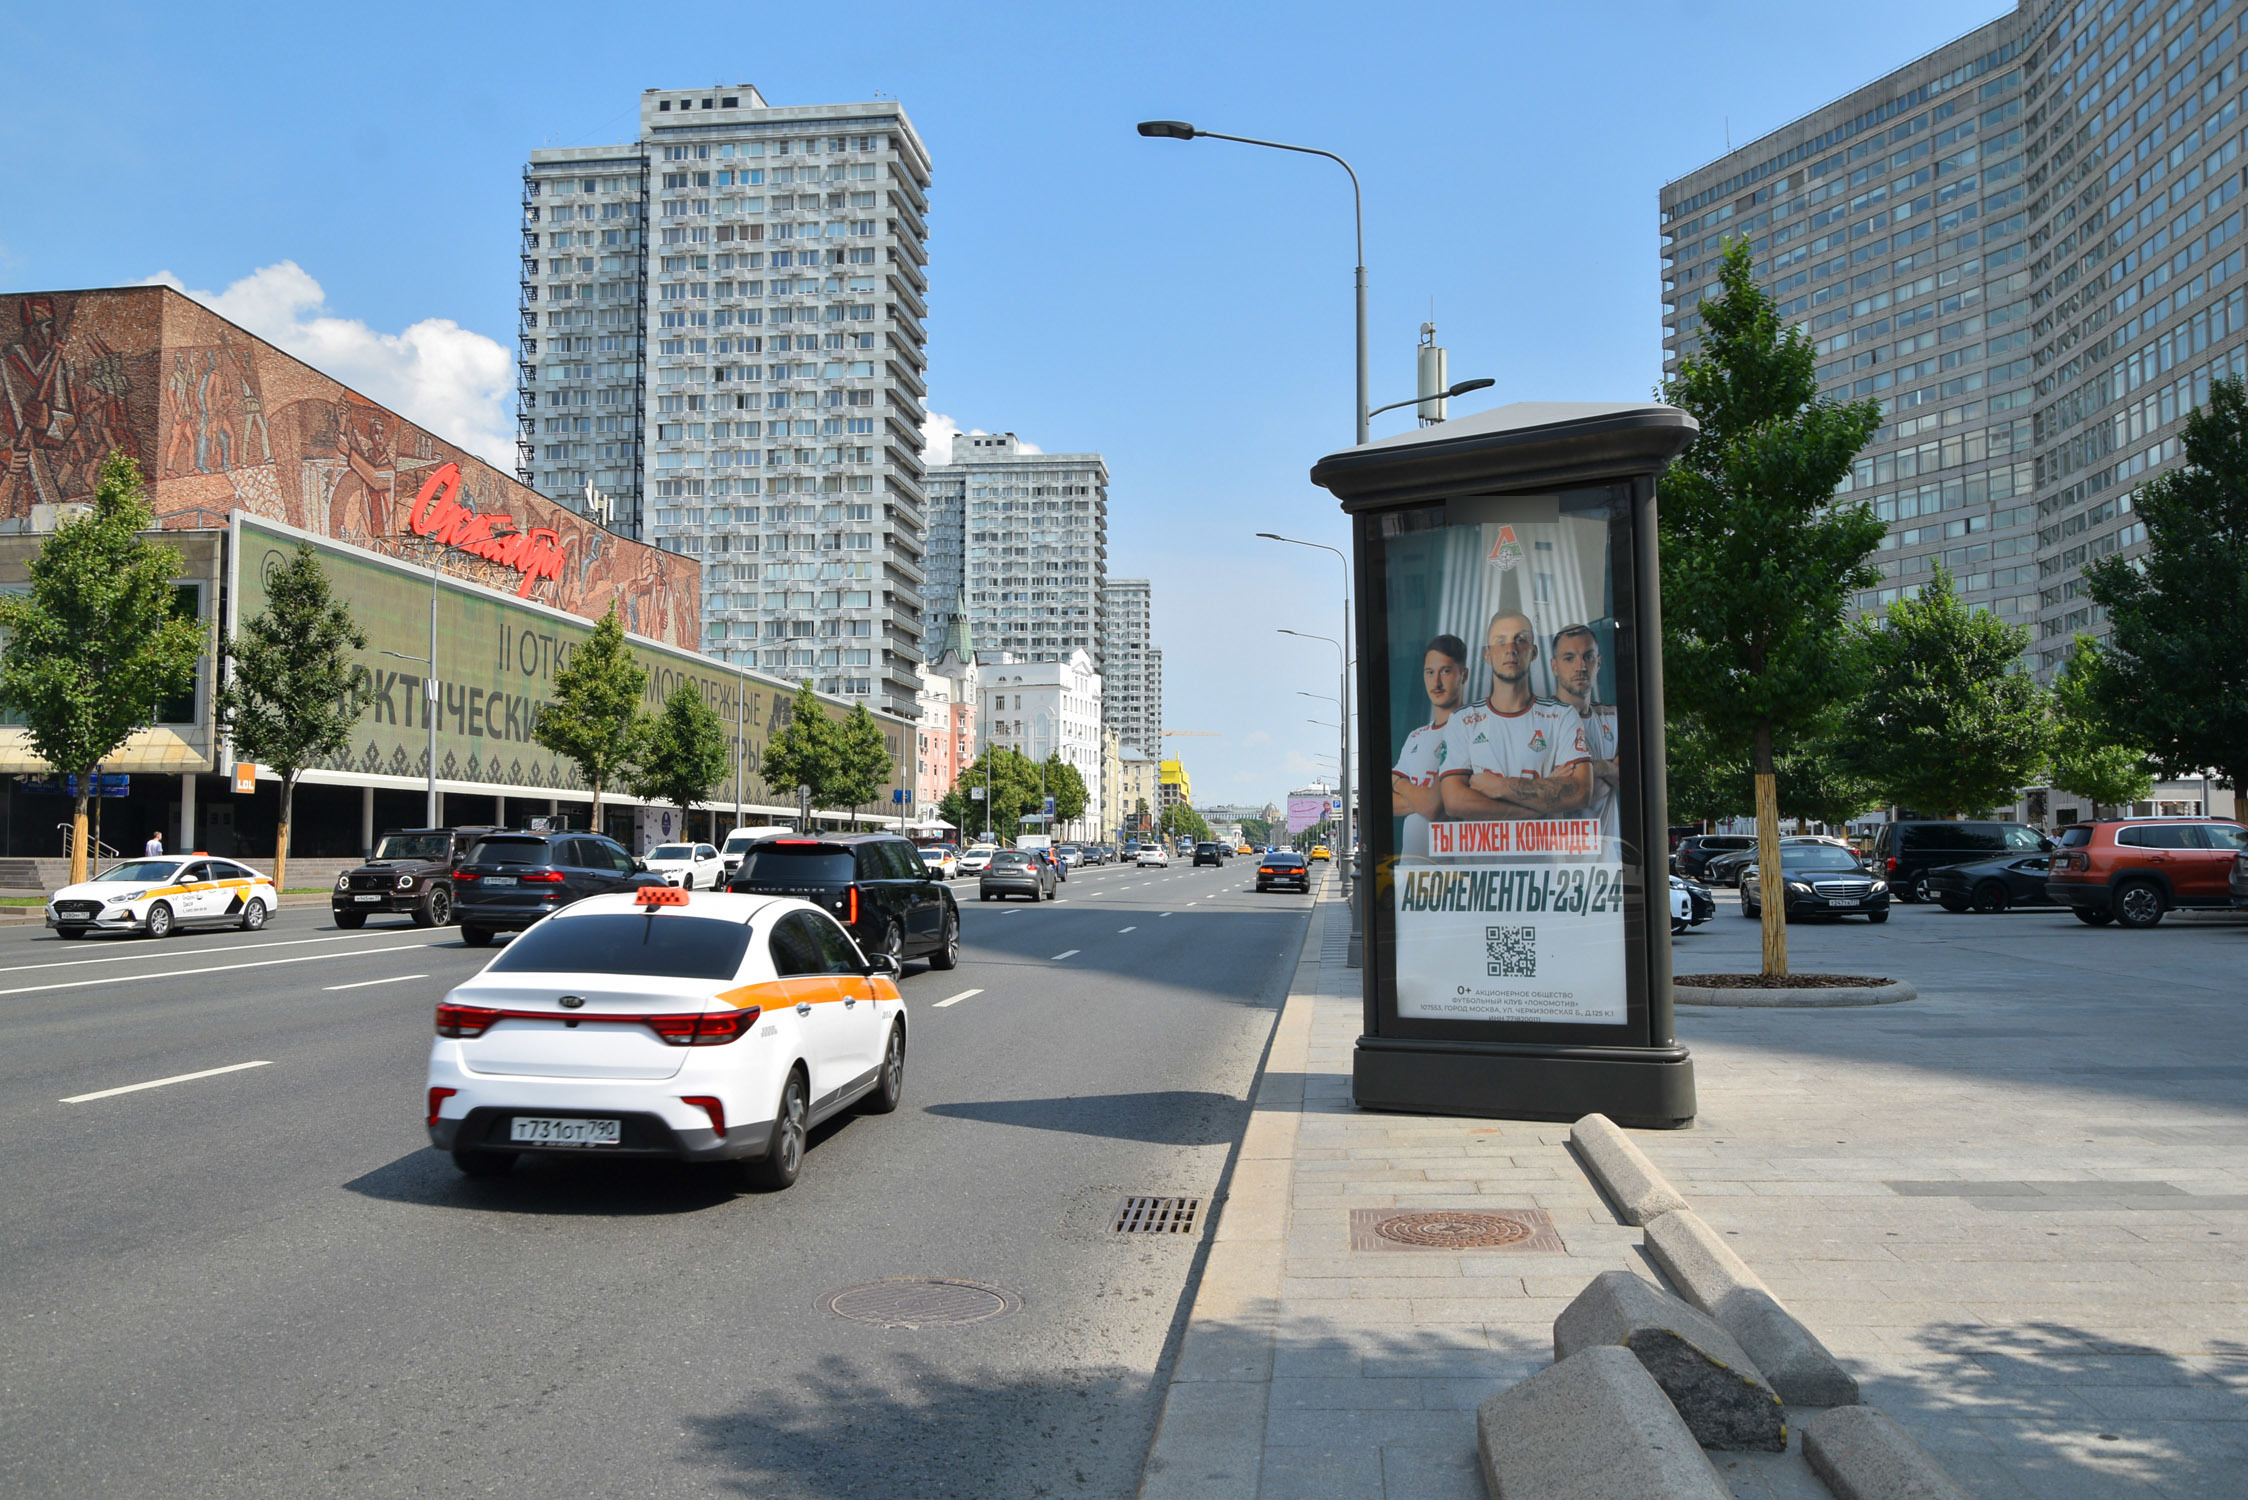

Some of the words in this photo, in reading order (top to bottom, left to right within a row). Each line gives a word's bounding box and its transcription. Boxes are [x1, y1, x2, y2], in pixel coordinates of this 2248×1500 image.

[336, 664, 558, 743] РКТИЧЕСКИ
[644, 664, 760, 726] МОДЕЖНЫЕ
[1431, 823, 1453, 852] ТЫ
[1459, 822, 1510, 852] НУЖЕН
[1401, 866, 1623, 916] АБОНЕМЕНТЫ-23/24
[1457, 985, 1472, 995] 0+
[1475, 989, 1530, 997] АКЦИОНЕРНОЕ
[1451, 997, 1502, 1005] ФУТБОЛЬНЫЙ
[1515, 1007, 1573, 1015] ЧЕРКИЗОВСКАЯ
